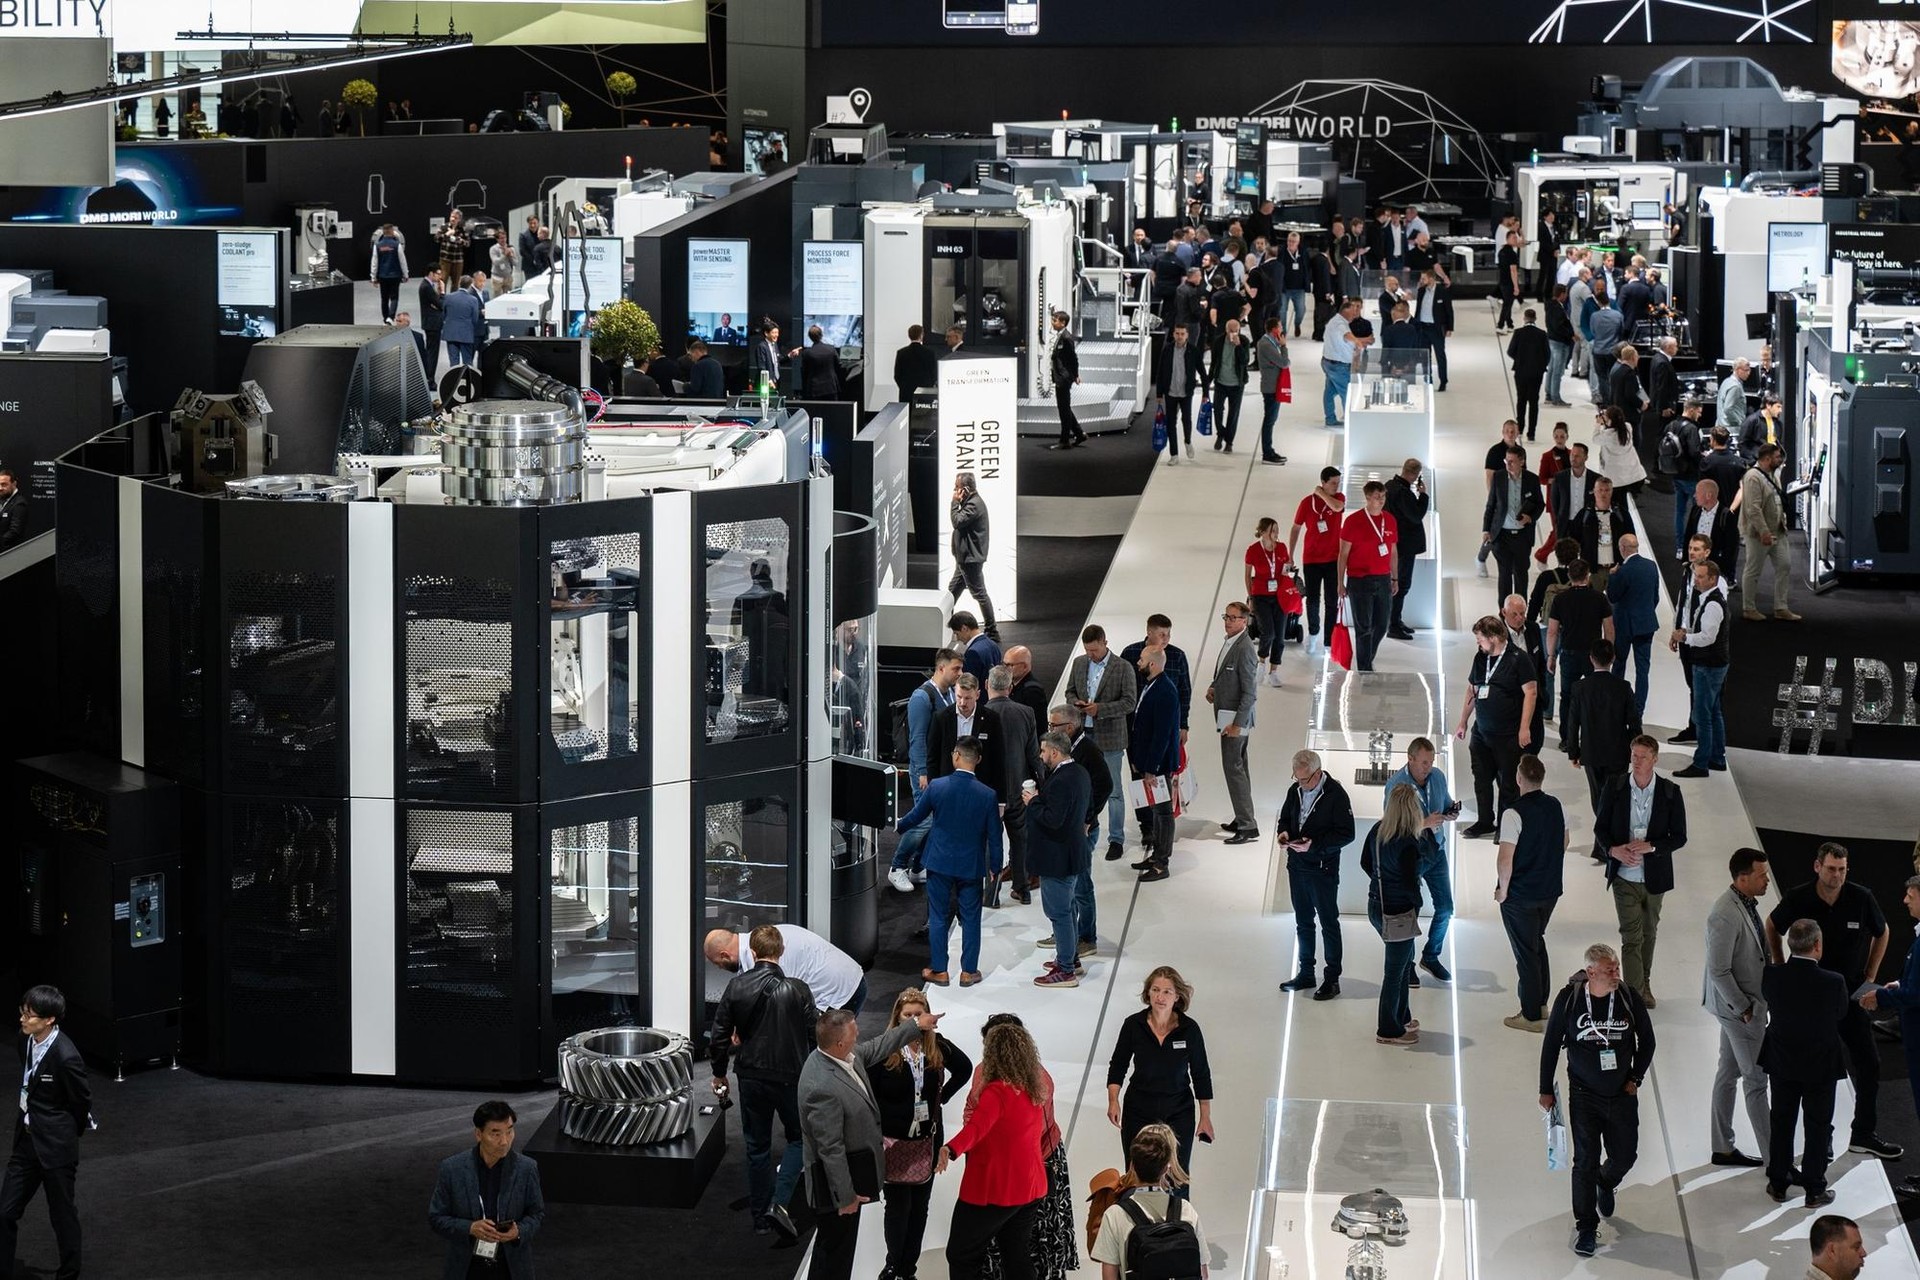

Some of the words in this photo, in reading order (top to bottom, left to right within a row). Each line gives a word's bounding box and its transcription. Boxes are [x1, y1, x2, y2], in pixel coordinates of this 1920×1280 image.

[0, 0, 106, 26] BILITY
[1196, 117, 1239, 129] DMG
[1295, 116, 1391, 138] WORLD
[109, 211, 142, 222] MORI
[143, 210, 177, 220] WORLD
[937, 245, 953, 253] INH
[1851, 250, 1875, 259] future
[1876, 250, 1884, 259] of
[1875, 259, 1882, 268] is
[956, 421, 975, 470] TRAN
[981, 420, 1000, 479] GREEN
